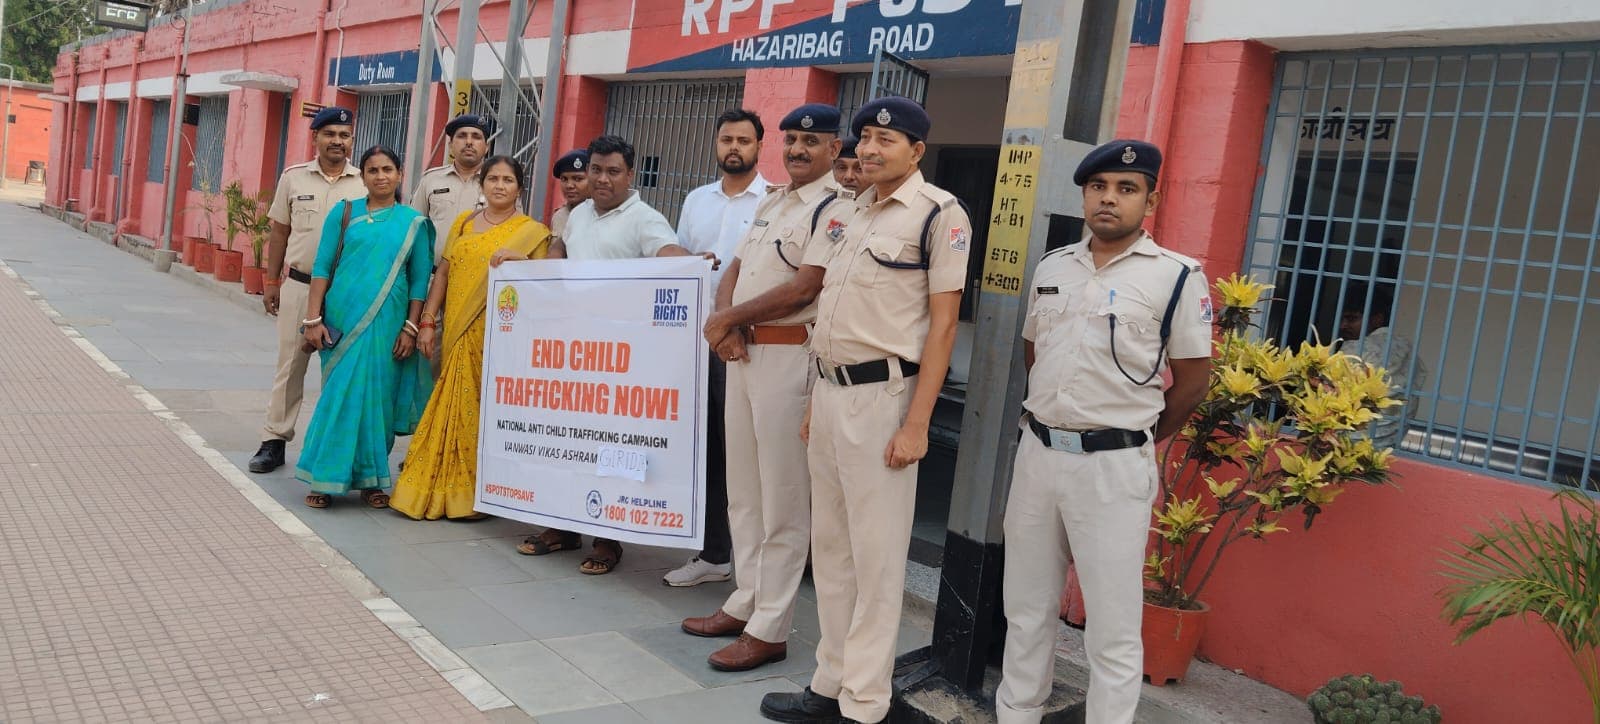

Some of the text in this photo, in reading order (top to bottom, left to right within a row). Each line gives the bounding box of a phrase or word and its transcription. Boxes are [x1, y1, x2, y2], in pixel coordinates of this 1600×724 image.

[681, 0, 795, 36] RPF
[731, 23, 934, 61] HAZARIBAG ROAD
[358, 62, 395, 83] Duty Room
[457, 92, 468, 106] 3
[1008, 149, 1032, 165] IMP
[1000, 197, 1018, 212] HT
[991, 247, 1018, 265] STG
[985, 272, 1020, 292] +300
[655, 289, 680, 304] JUST
[653, 305, 688, 321] RIGHTS
[531, 339, 631, 373] END CHILD
[495, 376, 679, 421] TRAFFICKING NOW!
[497, 419, 668, 448] NATIONAL ANTI CHILD TRAFFICKING CAMPAIGN
[504, 441, 598, 464] VANWASI VIKAS ASHRAM
[485, 484, 535, 502] #SPOTSTOPSAVE
[631, 497, 667, 508] HELPLINE
[604, 504, 684, 528] 1800 102 7222
